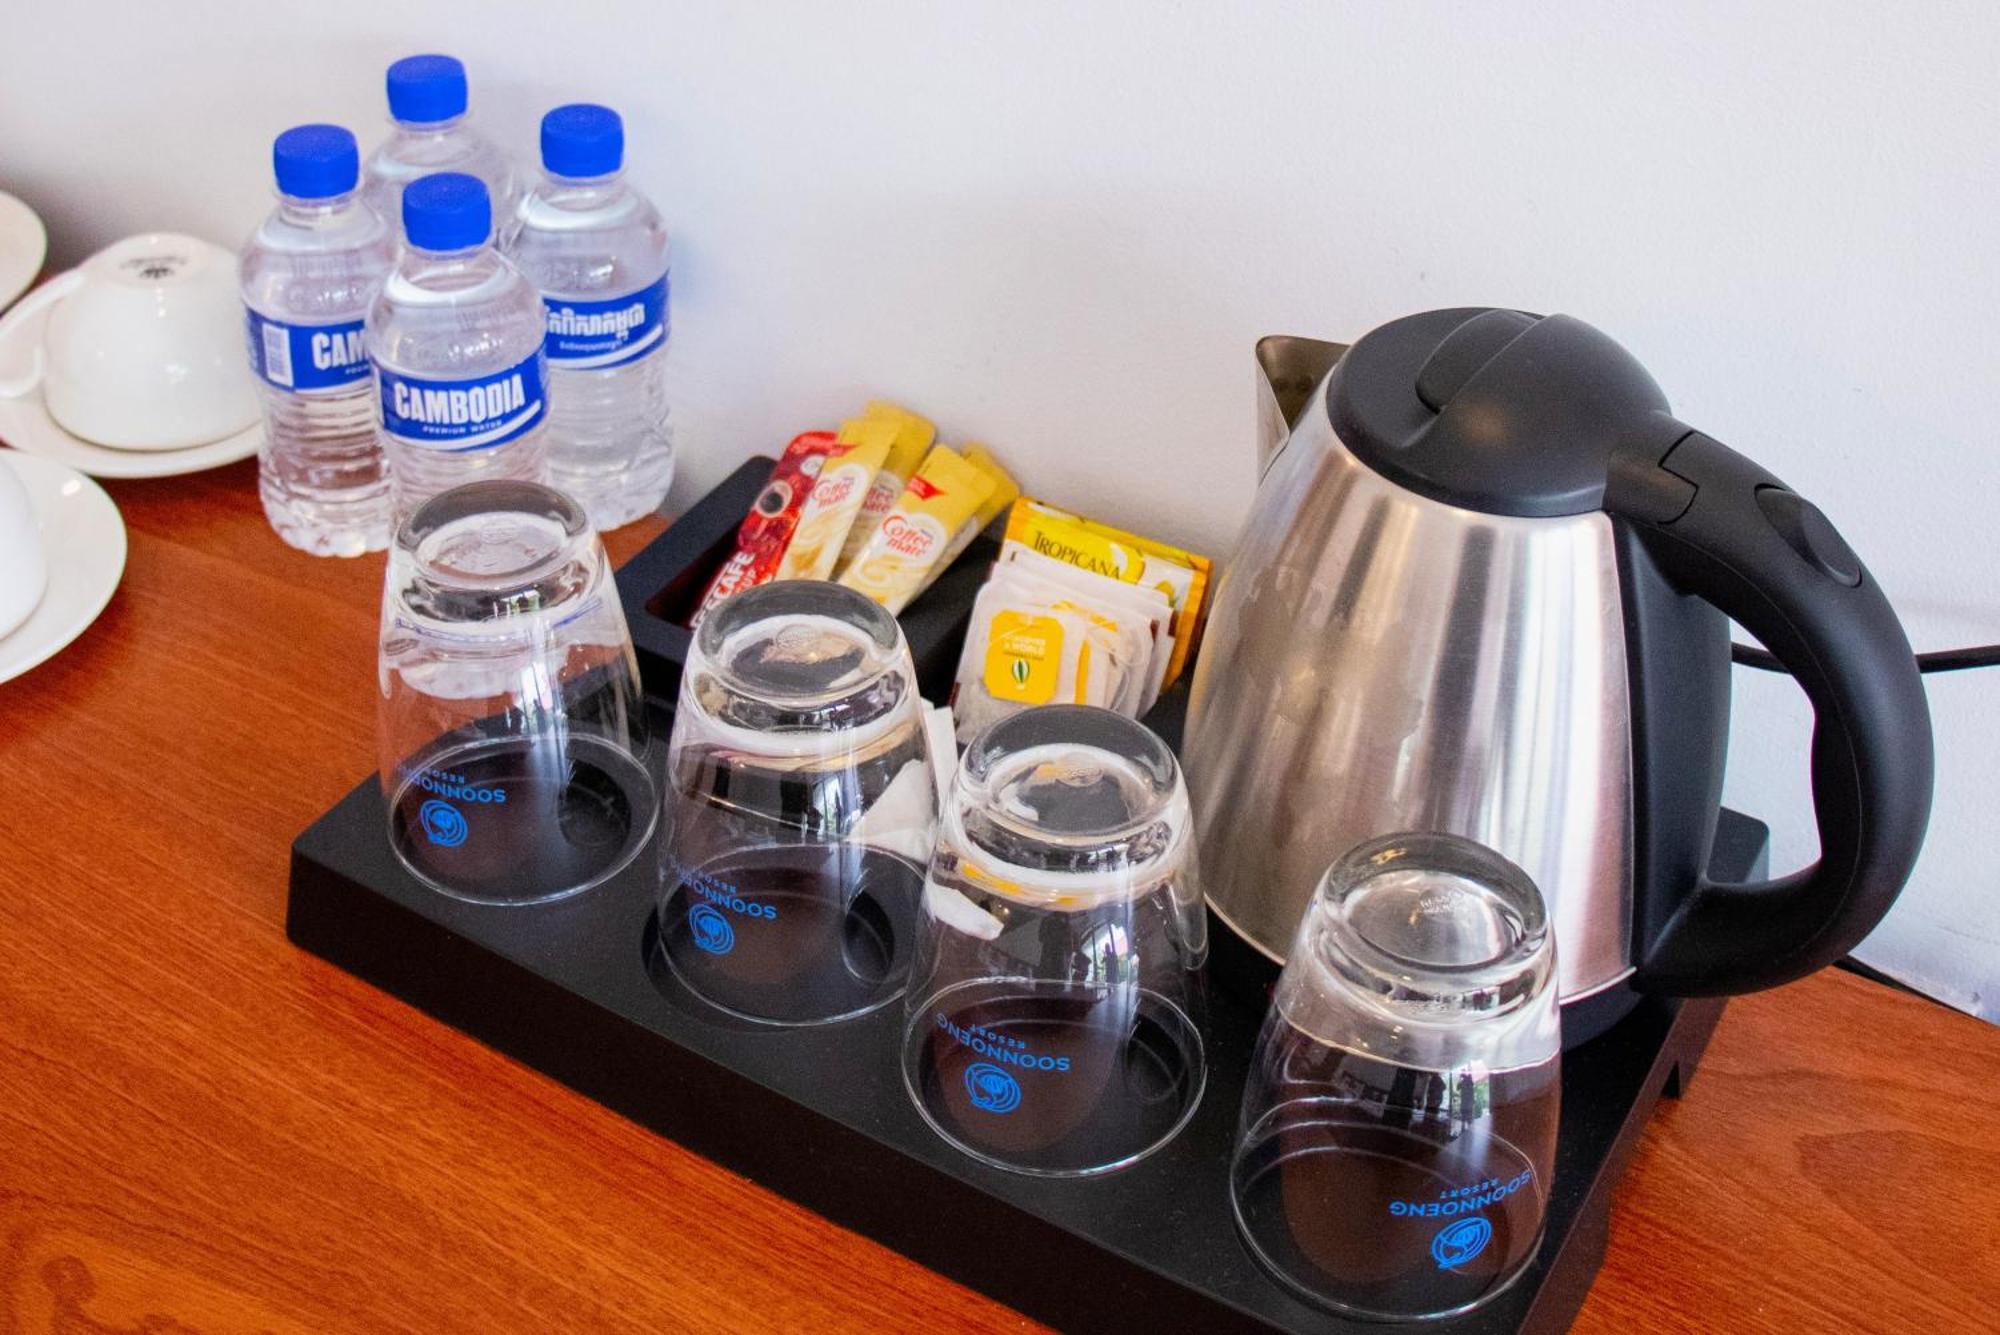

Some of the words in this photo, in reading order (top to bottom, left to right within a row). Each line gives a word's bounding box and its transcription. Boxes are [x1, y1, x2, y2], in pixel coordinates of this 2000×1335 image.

[393, 373, 525, 424] CAMBODIA
[422, 425, 466, 434] PREMIUM
[470, 420, 502, 432] WATER
[883, 515, 933, 549] Coffee
[1034, 531, 1120, 580] TROPICANA
[936, 1012, 1071, 1071] SOONNOENG
[970, 1024, 1025, 1049] RESORT
[1389, 1169, 1532, 1216] SOONNOENG
[1440, 1178, 1499, 1199] RESORT
